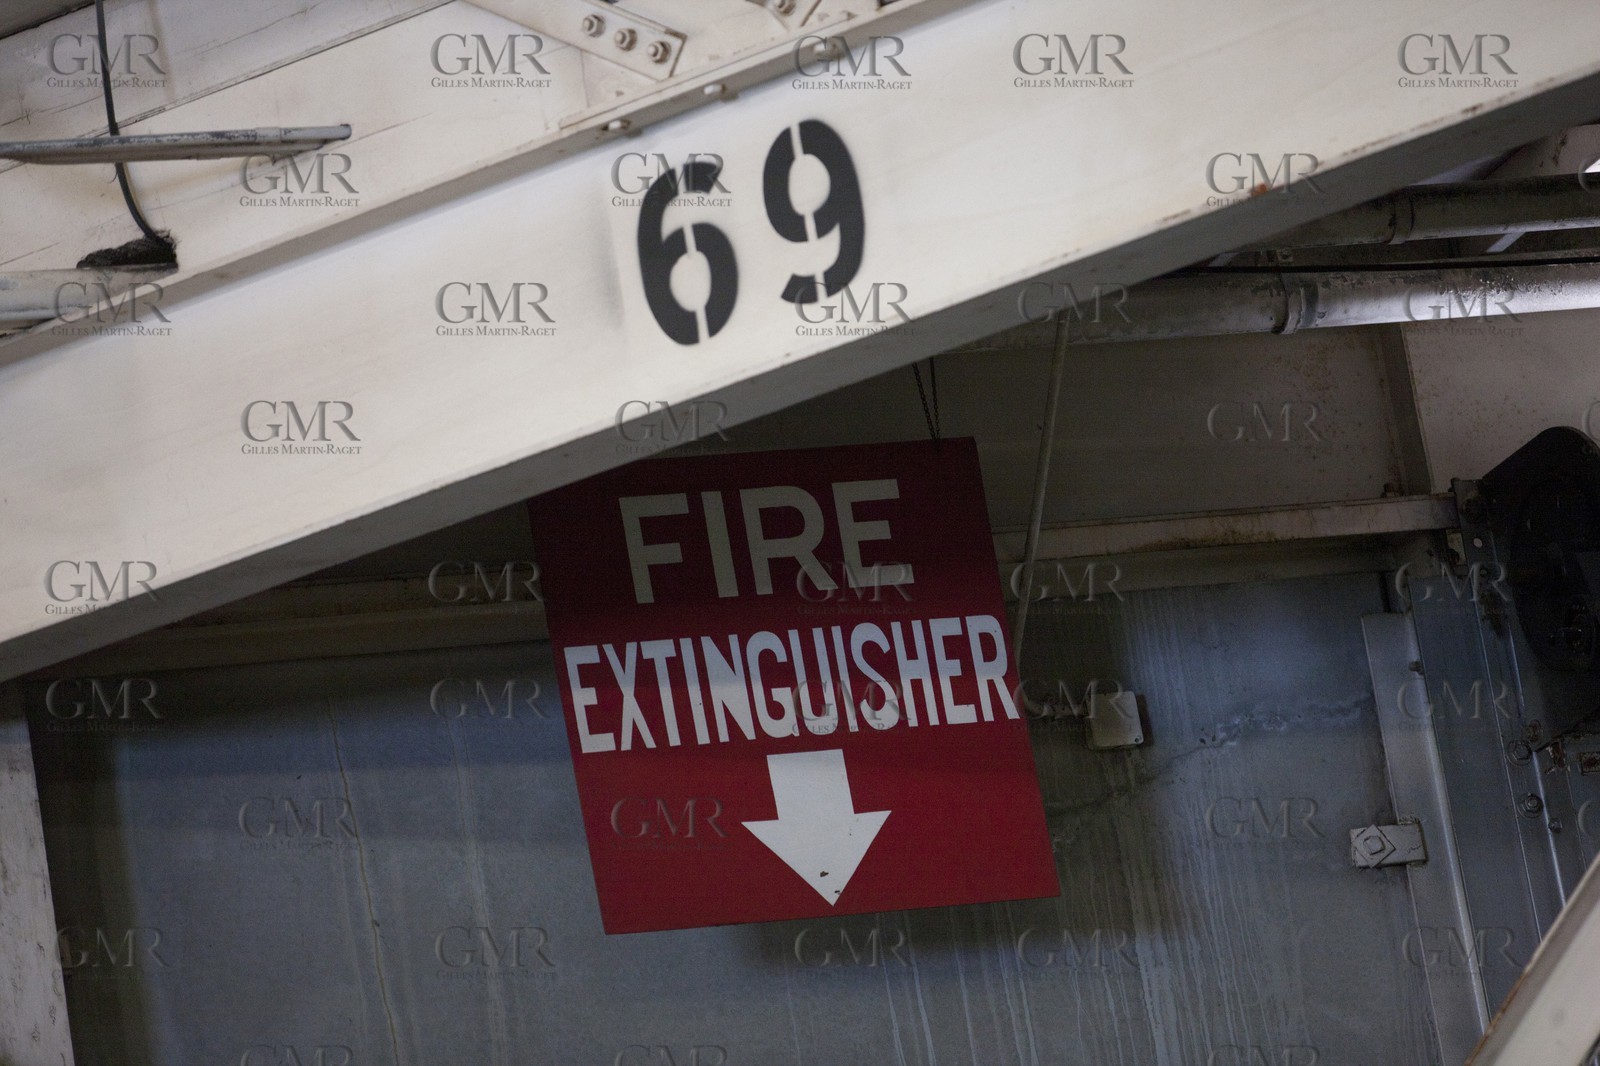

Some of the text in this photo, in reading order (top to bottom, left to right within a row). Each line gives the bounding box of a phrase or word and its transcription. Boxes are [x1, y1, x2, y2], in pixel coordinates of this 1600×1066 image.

[637, 119, 865, 345] 69
[618, 478, 915, 604] FIRE
[564, 614, 1021, 754] EXTINGUISHER
